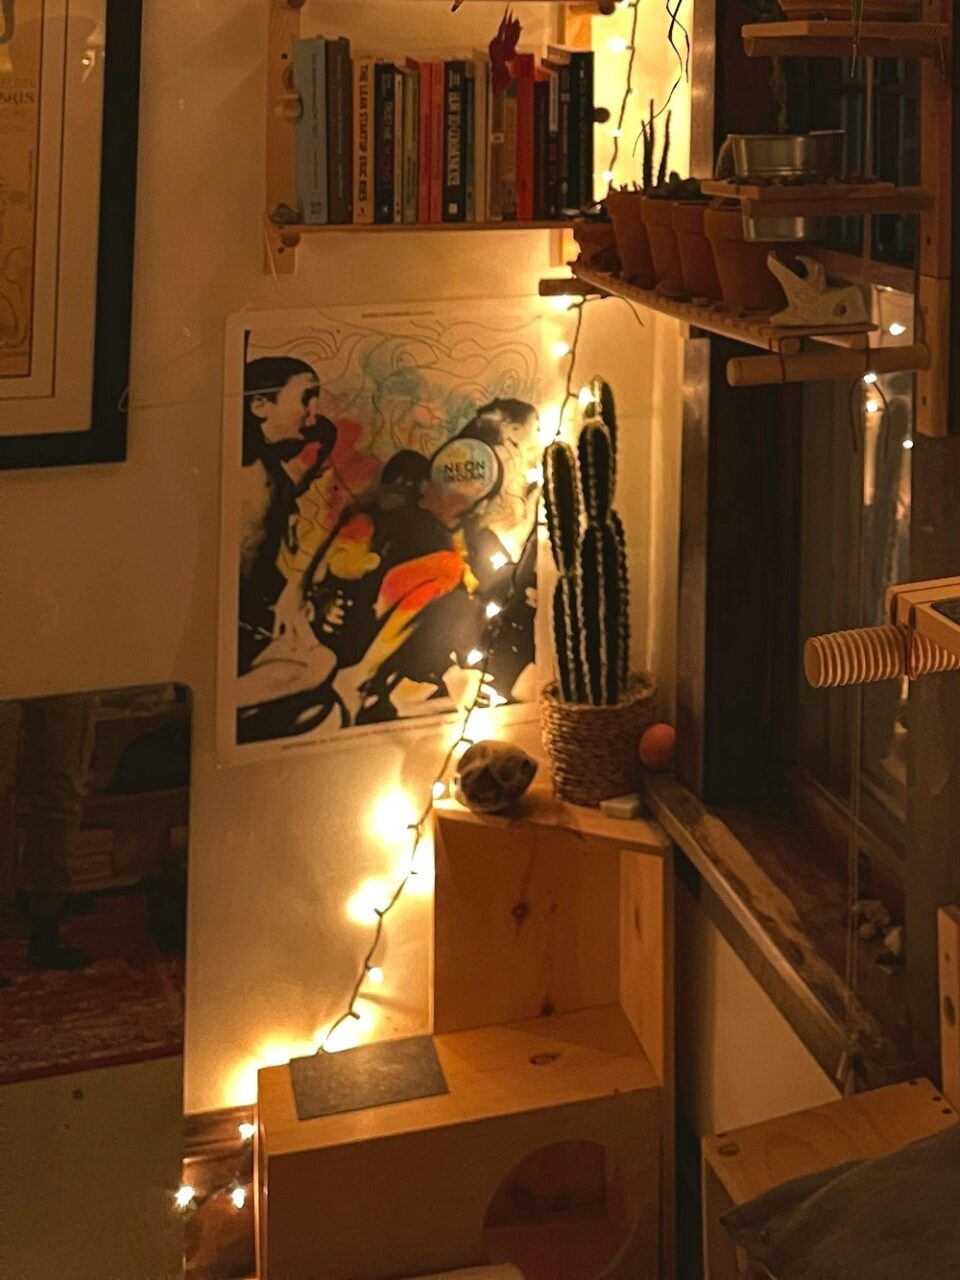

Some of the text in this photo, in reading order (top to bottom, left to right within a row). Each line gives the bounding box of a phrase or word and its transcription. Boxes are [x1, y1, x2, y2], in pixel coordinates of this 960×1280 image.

[359, 65, 369, 202] THE LEAN STARTUP ERIC RIES
[444, 460, 486, 472] NEON
